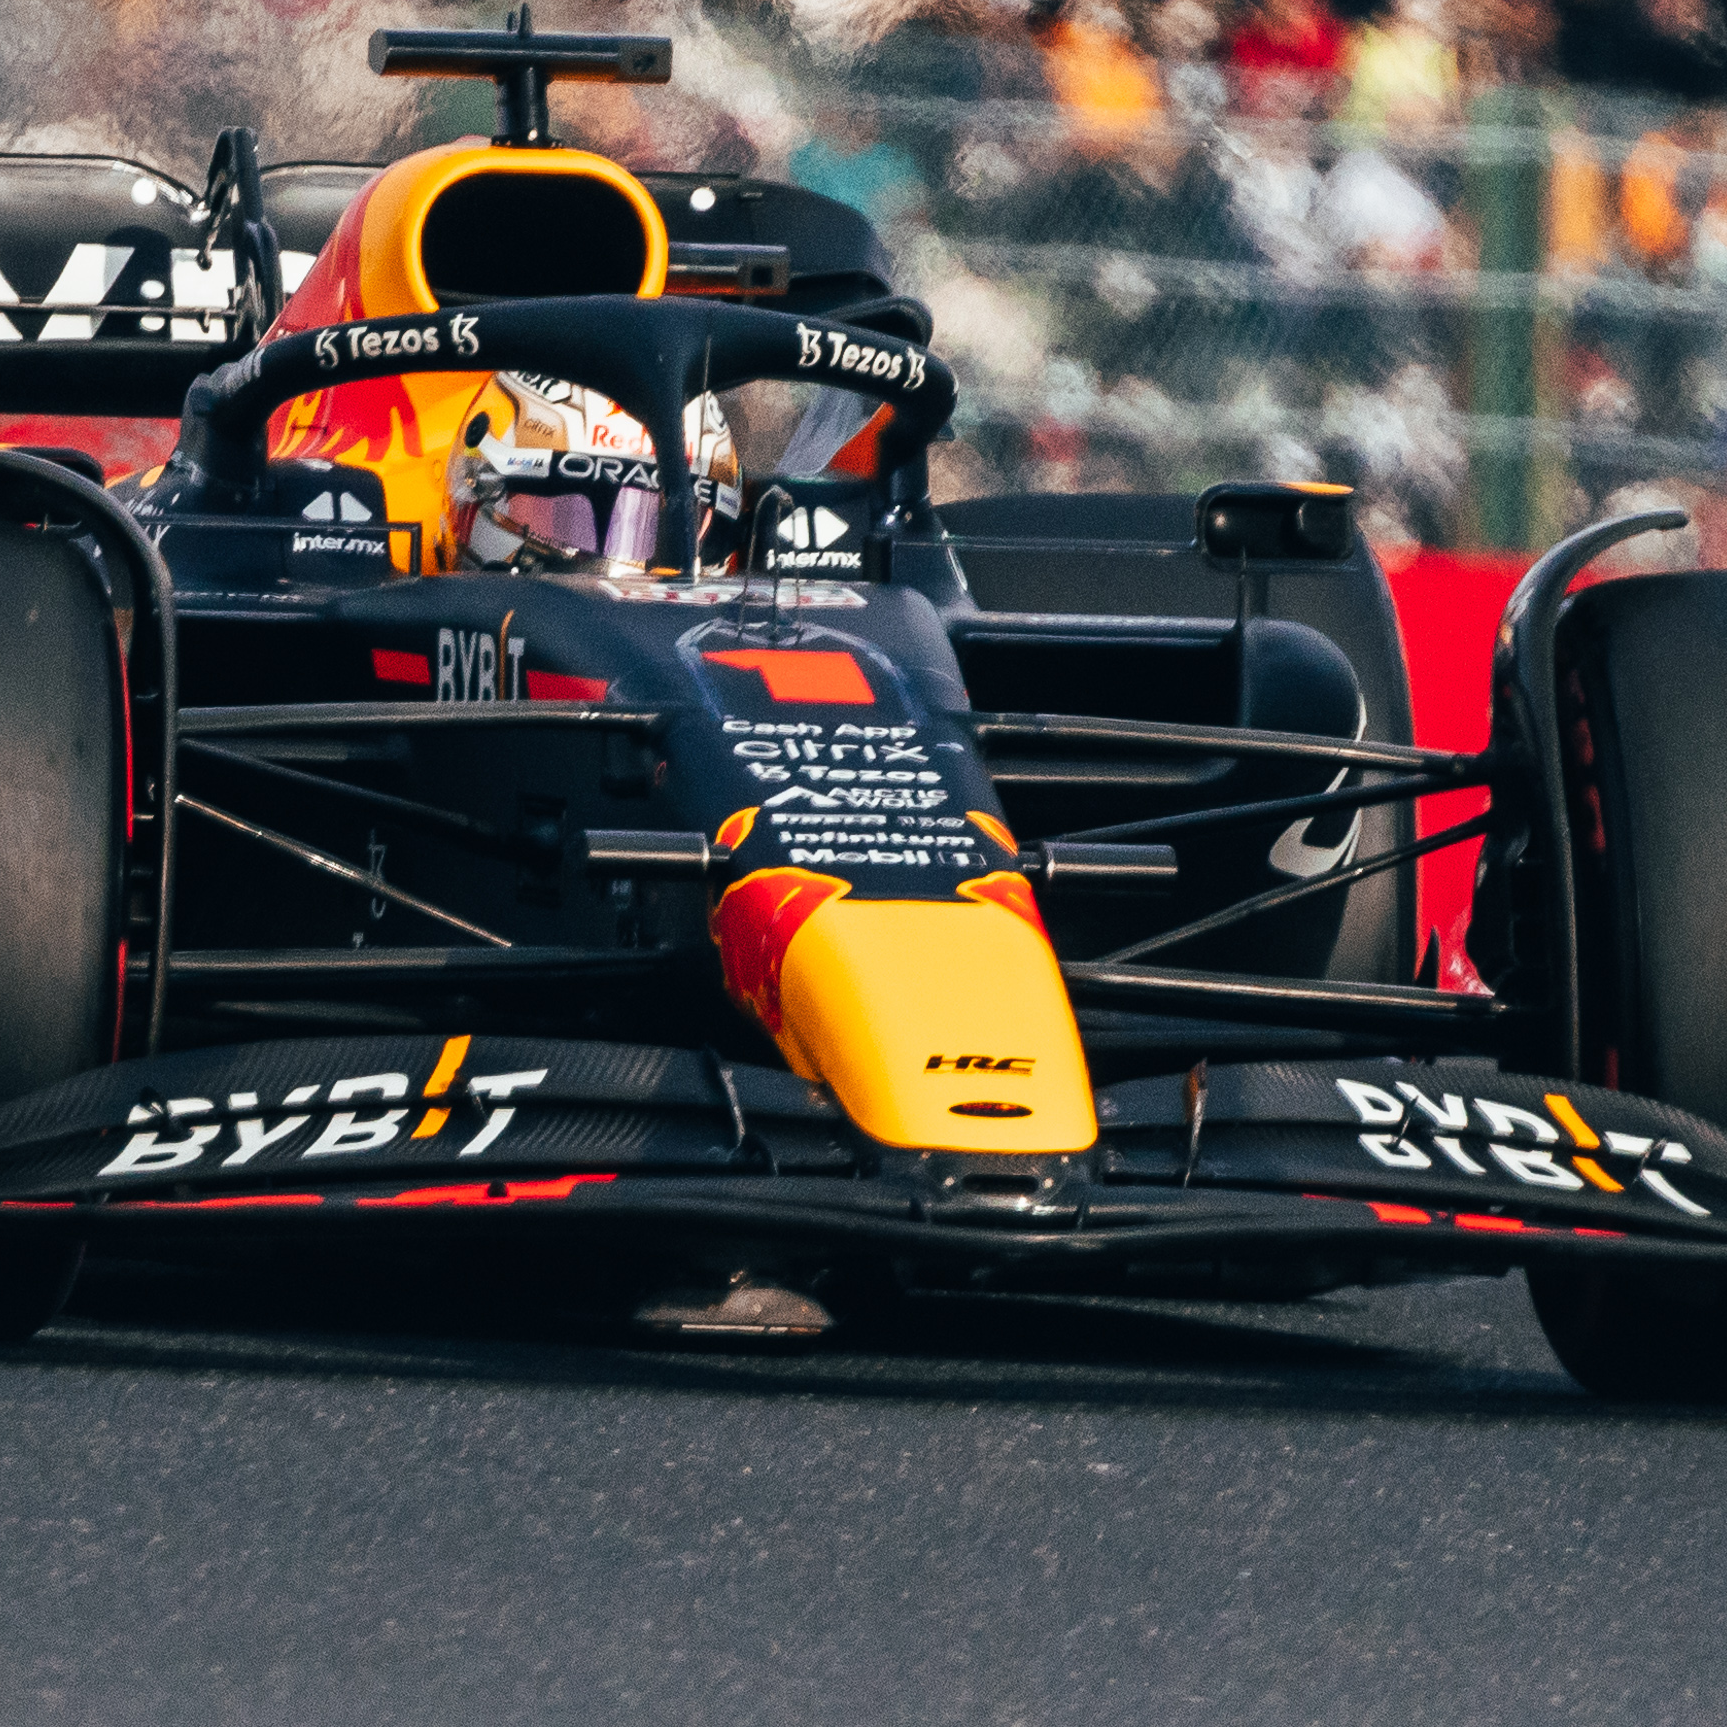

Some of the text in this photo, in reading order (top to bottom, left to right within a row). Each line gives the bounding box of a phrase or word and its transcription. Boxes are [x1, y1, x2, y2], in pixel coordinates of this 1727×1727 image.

[346, 325, 440, 360] Tezos
[827, 330, 903, 380] Tezos
[437, 609, 526, 703] BYBIT
[701, 649, 875, 704] 1
[722, 720, 917, 739] Cash App
[797, 764, 942, 784] Tezos
[790, 848, 931, 864] Mobil
[924, 1054, 1037, 1074] HRC
[98, 1035, 548, 1176] BYBIT
[1336, 1078, 1711, 1217] BYBIT
